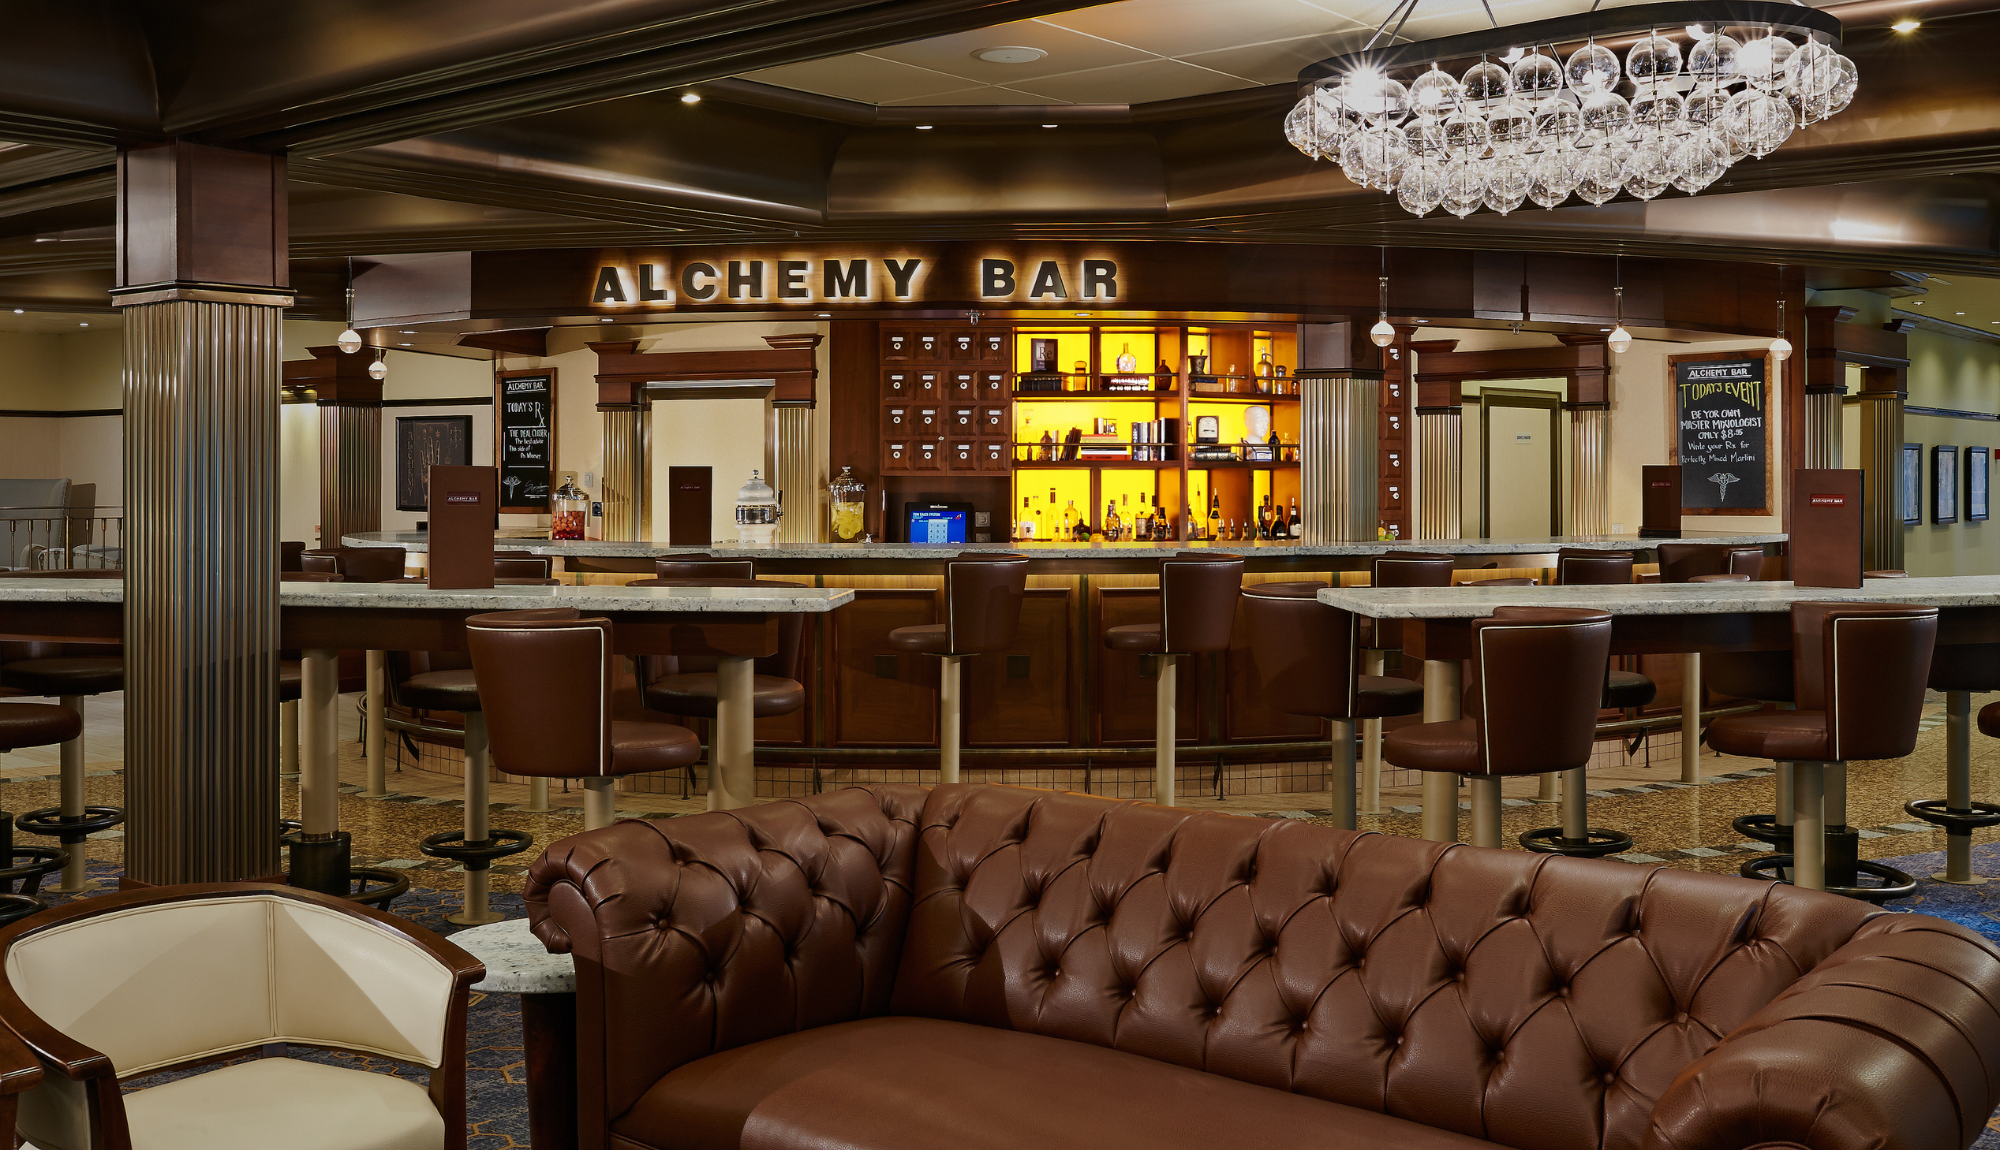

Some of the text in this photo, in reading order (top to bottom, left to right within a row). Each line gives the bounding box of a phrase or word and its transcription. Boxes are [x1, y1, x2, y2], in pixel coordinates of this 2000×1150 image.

[592, 258, 1117, 303] ALCHEMY BAR
[1038, 346, 1052, 359] Re
[1688, 367, 1748, 378] ALCHEMY BAR
[507, 381, 544, 391] ALCHEMY BAR
[1725, 381, 1762, 411] EVENT
[1691, 410, 1702, 420] BE
[1721, 408, 1740, 418] OWN
[1680, 419, 1710, 430] MASTER
[1698, 431, 1719, 440] ONLY
[1706, 444, 1723, 453] your
[1740, 441, 1750, 449] for
[1730, 451, 1756, 463] Martini
